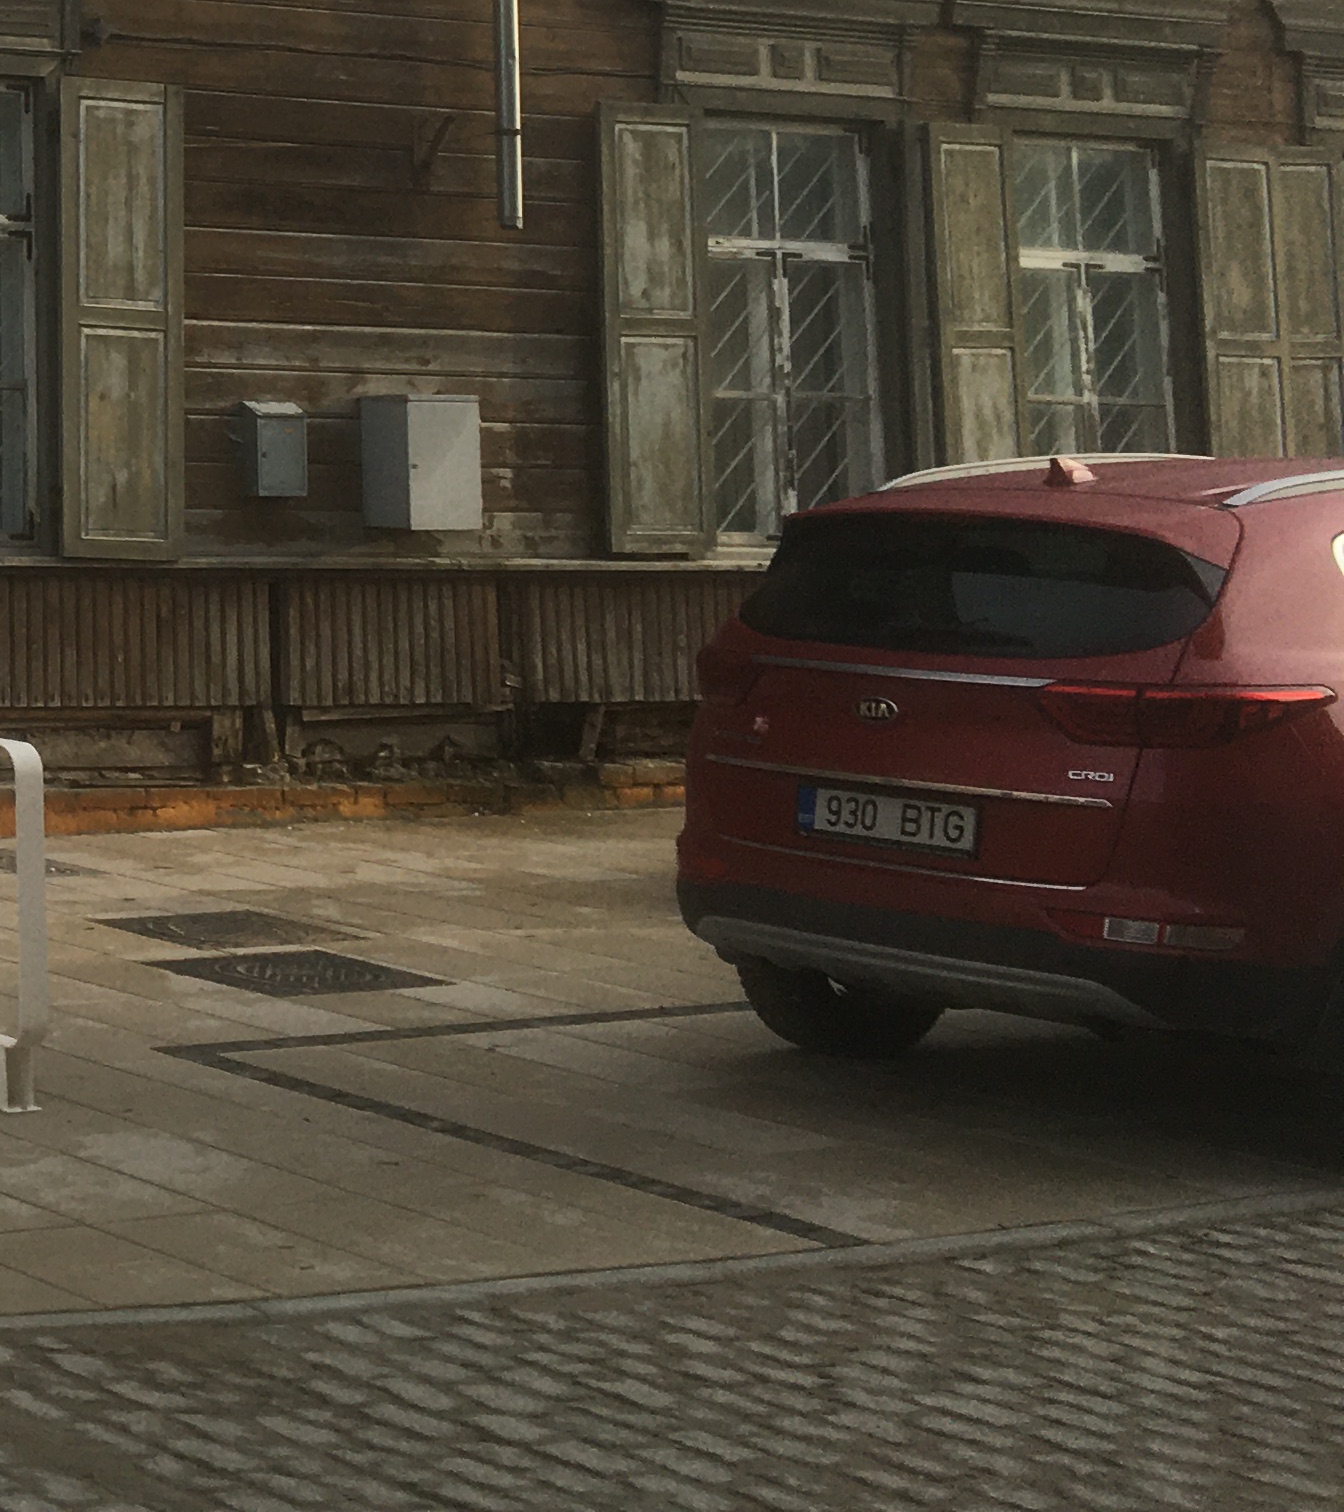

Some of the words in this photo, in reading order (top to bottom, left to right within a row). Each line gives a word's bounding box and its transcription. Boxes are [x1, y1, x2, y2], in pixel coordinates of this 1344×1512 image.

[859, 700, 890, 719] KIA
[825, 794, 879, 832] 930
[900, 803, 966, 844] BTG
